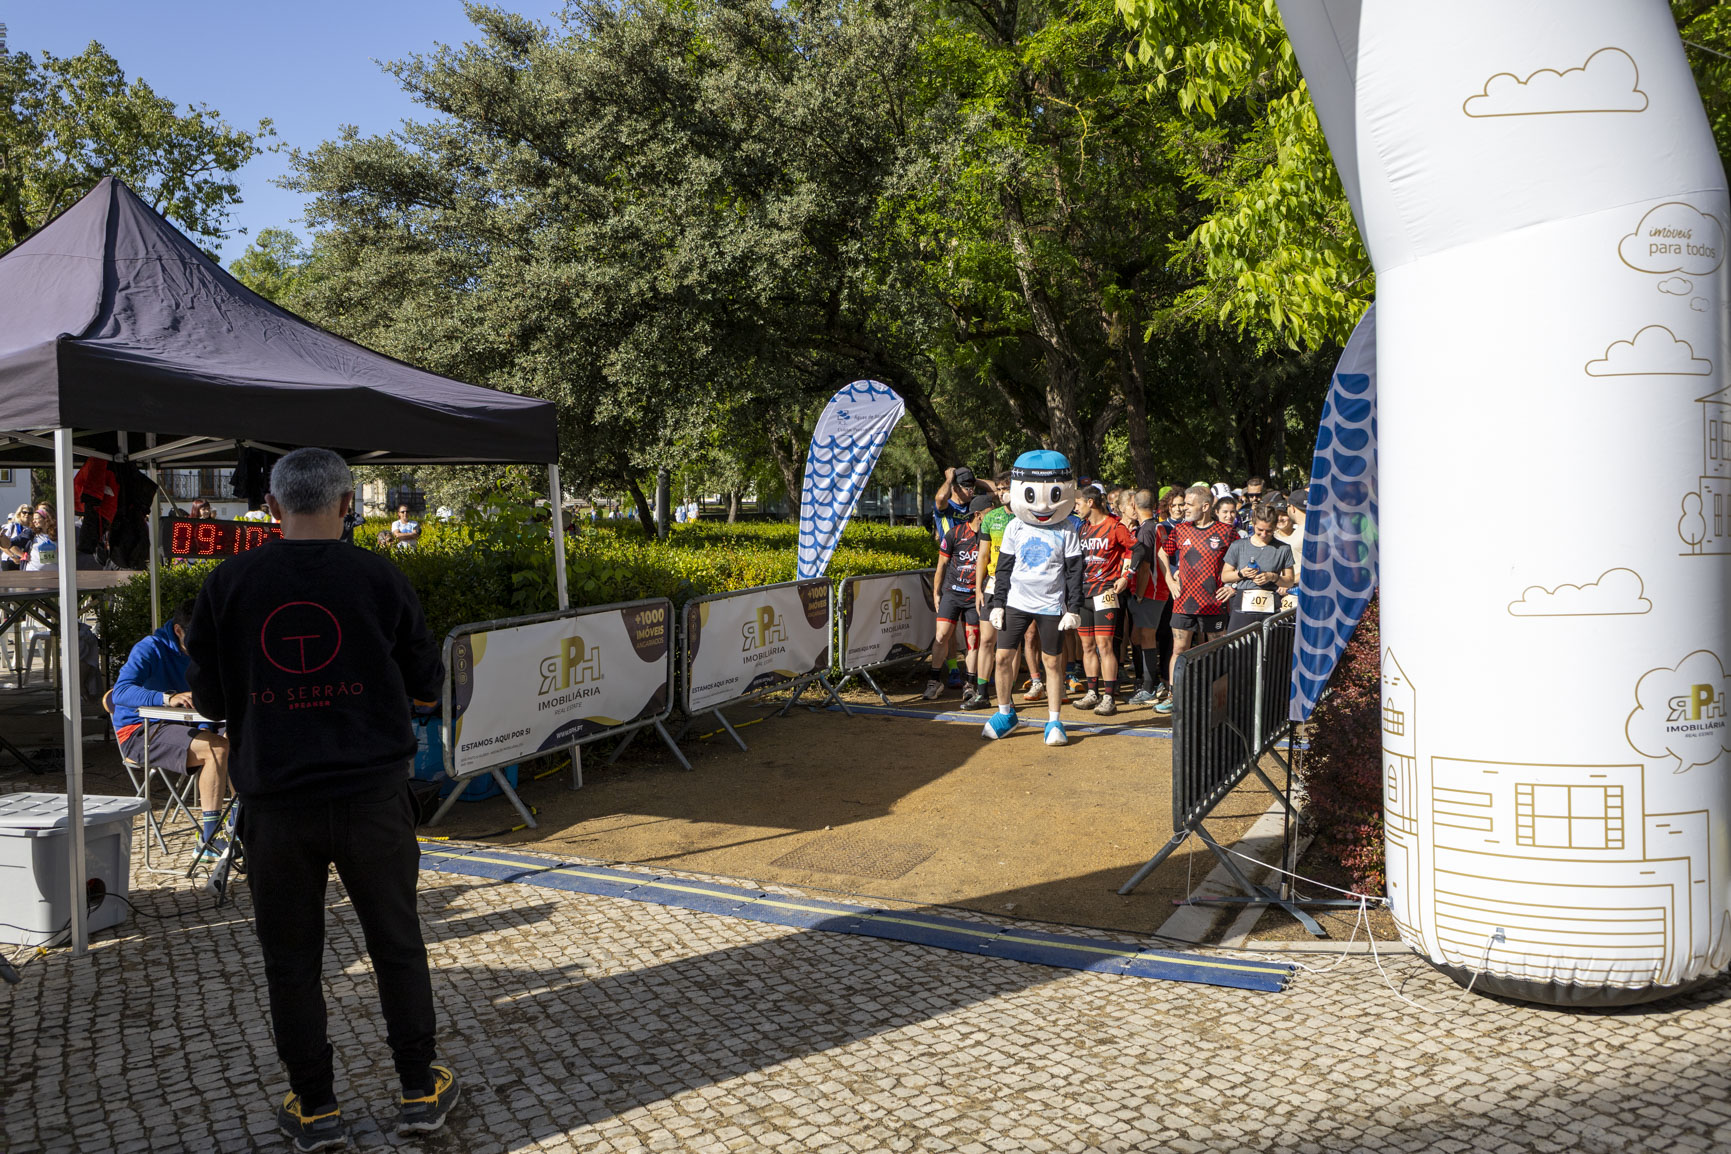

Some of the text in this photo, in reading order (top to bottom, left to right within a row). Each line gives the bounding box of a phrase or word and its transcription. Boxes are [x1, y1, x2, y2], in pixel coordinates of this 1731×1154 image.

[1649, 224, 1692, 240] imóveis
[1649, 242, 1716, 259] para todos
[959, 551, 979, 561] SAR
[808, 585, 828, 599] +1000
[1250, 596, 1268, 605] 207
[635, 608, 665, 625] +1000
[635, 625, 665, 640] IMÓVEIS
[881, 622, 910, 635] IMOBILIÁRIA
[743, 645, 786, 665] IMOBILIÁRIA
[249, 681, 364, 705] TÓ SERRÃO
[692, 683, 714, 694] ESTAMOS
[713, 680, 725, 689] AQUI
[725, 678, 734, 686] POR
[289, 700, 331, 710] SPEAKER
[538, 686, 601, 711] IMOBILIÁRIA
[554, 702, 583, 715] REAL ESTATE
[1666, 721, 1726, 732] IMOBILIÁRIA
[461, 727, 531, 752] ESTAMOS AQUI POR SI
